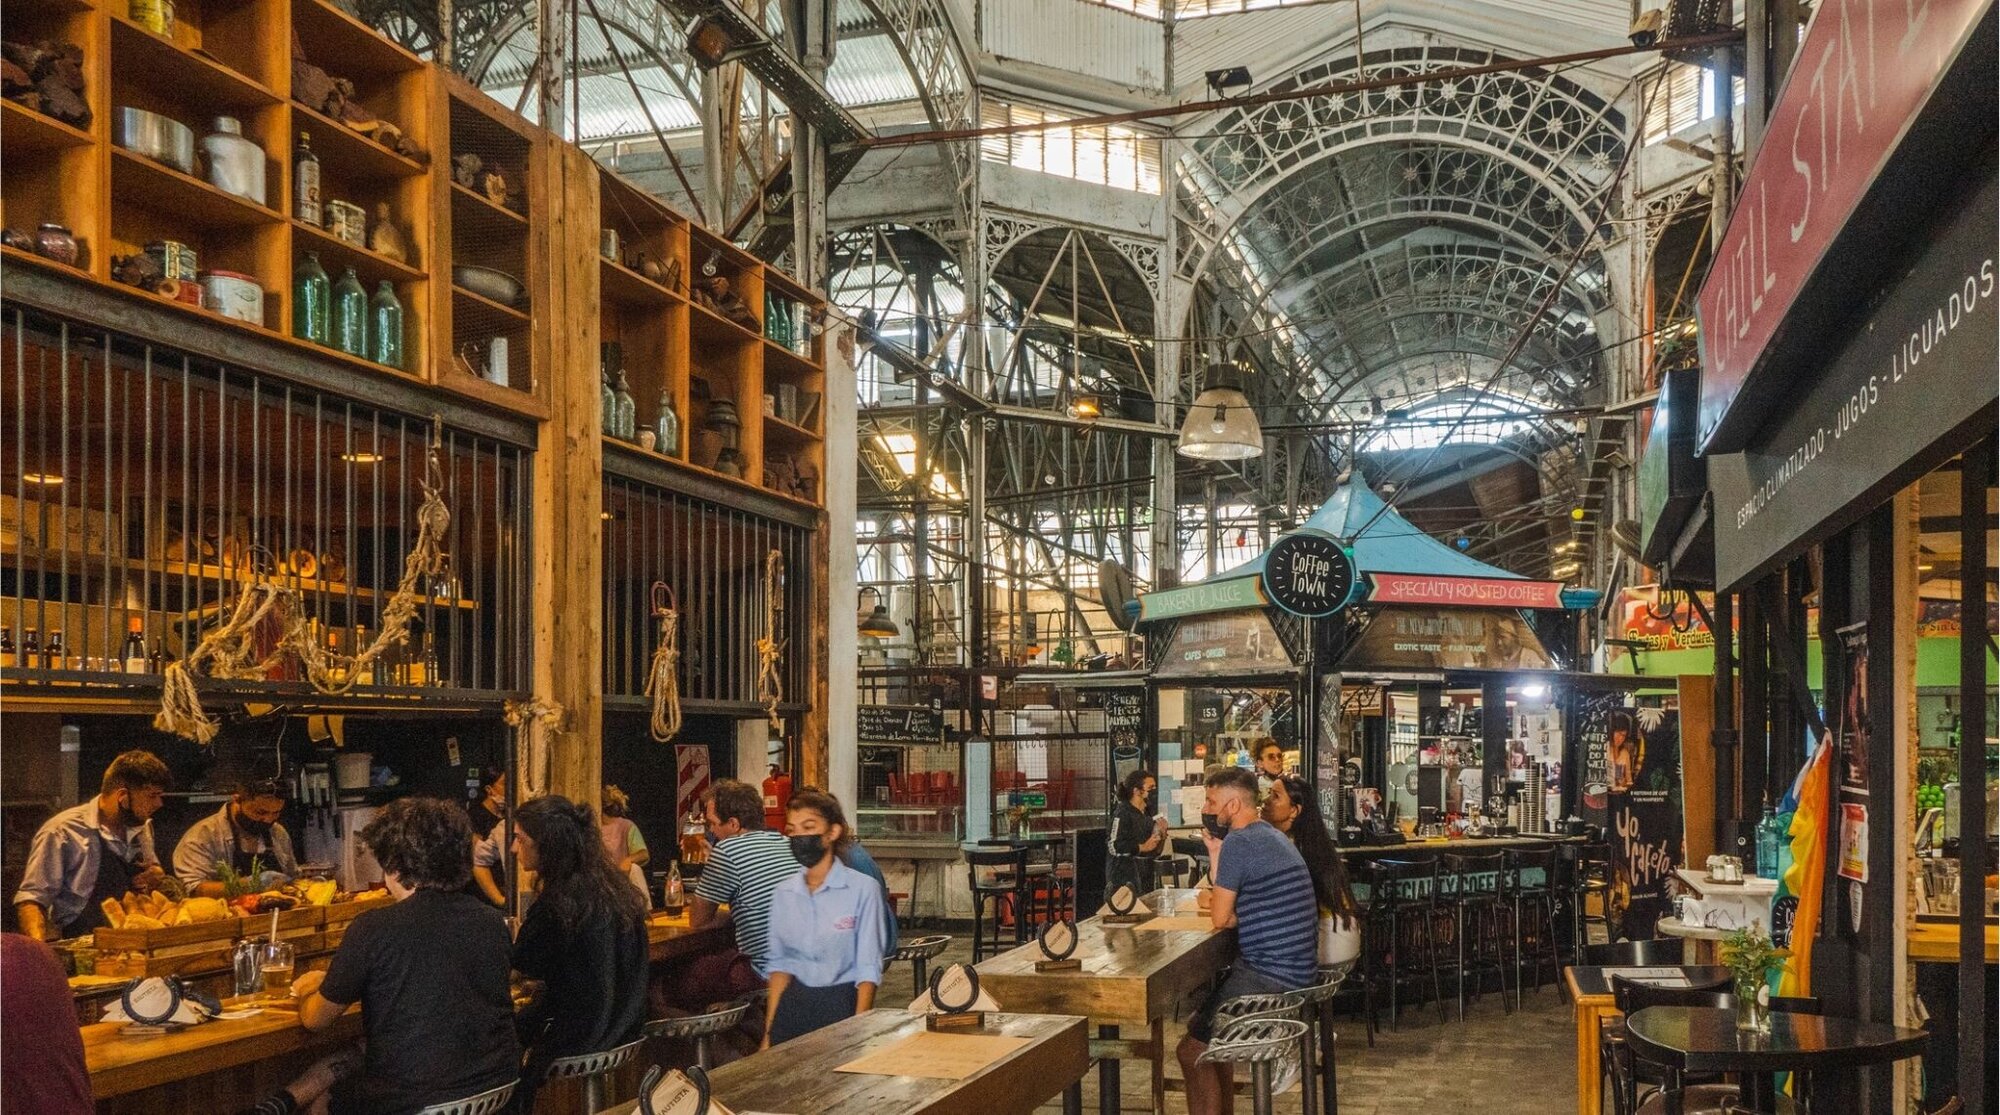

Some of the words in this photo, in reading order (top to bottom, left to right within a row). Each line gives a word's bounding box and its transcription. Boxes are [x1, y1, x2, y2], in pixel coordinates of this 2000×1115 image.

[1714, 179, 1776, 374] CHILL
[1737, 487, 1765, 530] ESPACIO
[1765, 428, 1826, 501] CLIMATIZADO
[1835, 376, 1878, 439] JUGOS
[1893, 259, 1994, 383] LICUADOS
[1157, 588, 1195, 613] BAKERY
[1209, 585, 1242, 607] JUICE
[1391, 580, 1454, 599] SPECIALTY
[1456, 584, 1506, 600] ROASTED
[1509, 586, 1545, 601] COFFEE
[1394, 643, 1419, 651] EXOTIC
[1671, 624, 1715, 648] Verdura
[1203, 707, 1217, 718] 153
